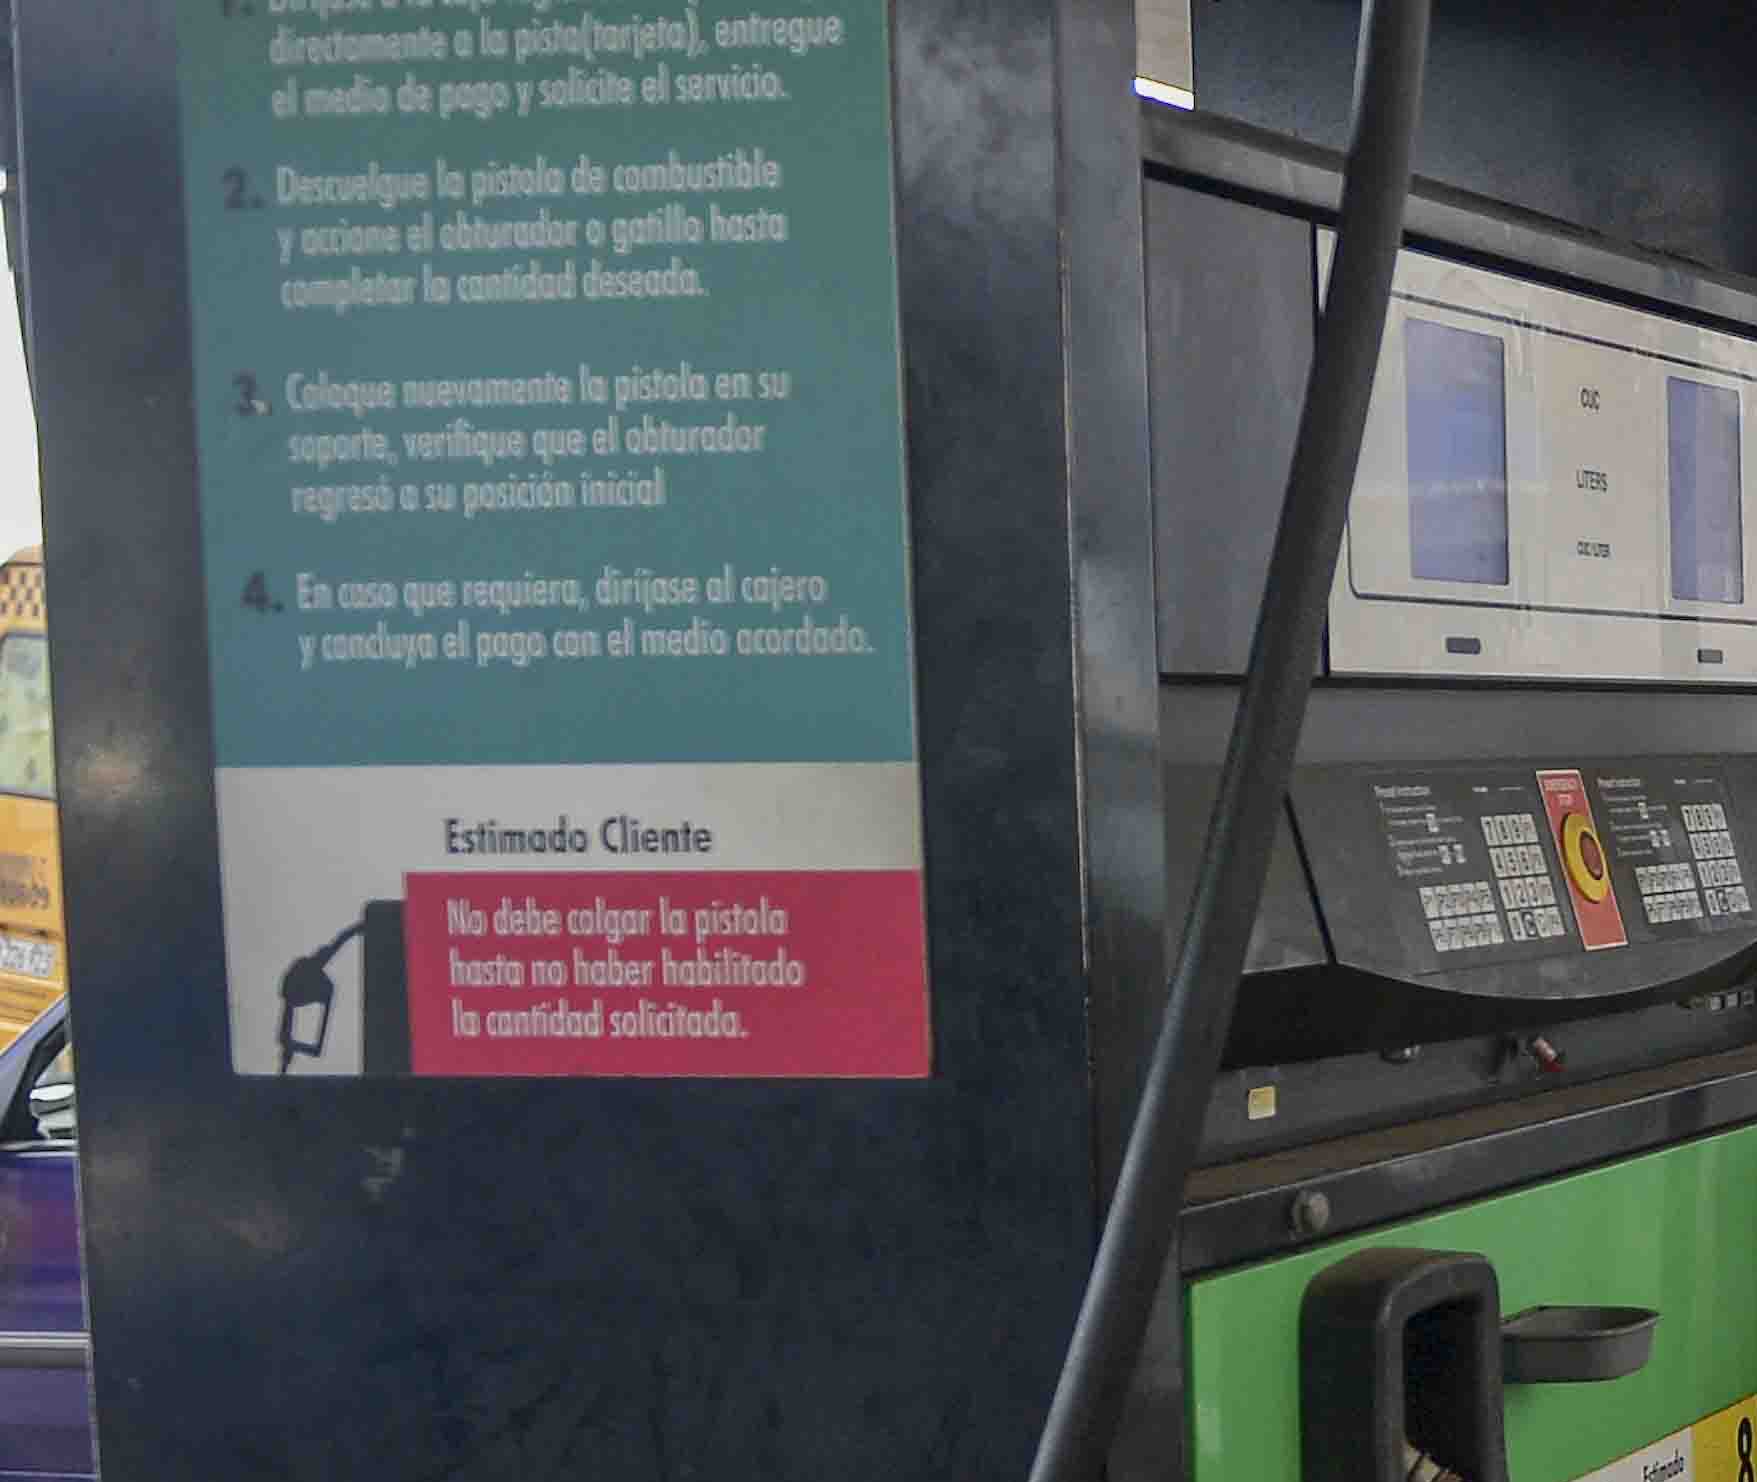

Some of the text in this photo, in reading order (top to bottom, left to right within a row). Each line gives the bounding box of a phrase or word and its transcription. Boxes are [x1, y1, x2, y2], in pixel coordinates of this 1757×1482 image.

[453, 30, 473, 56] a
[480, 16, 507, 55] la
[715, 14, 842, 53] entregue
[271, 62, 788, 118] el medio de pago y solicite el servicio.
[222, 148, 782, 209] 2. Descuelgue la pistola de combustible
[277, 203, 787, 263] y accione el obturador o gatillo hasta
[282, 257, 708, 313] completar la cantidad deseada.
[285, 370, 394, 417] Coloque
[402, 372, 569, 409] nuevamente
[580, 364, 608, 401] la
[615, 361, 708, 410] pistola
[715, 371, 750, 400] en
[759, 371, 788, 400] su
[288, 412, 765, 469] soporte, verifique que el obturador
[400, 484, 418, 511] a
[424, 483, 454, 510] su
[463, 471, 574, 518] posición
[241, 571, 284, 614] 4.
[296, 573, 331, 608] En
[338, 582, 397, 608] caso
[403, 580, 453, 616] que
[463, 570, 588, 613] requiera,
[705, 564, 735, 603] al
[741, 565, 827, 612] cajero
[300, 612, 876, 669] y concluya el pago con el medio acordado.
[443, 814, 713, 853] Estimado Cliente
[447, 896, 789, 944] No debe colgar la pistola
[450, 946, 806, 986] hasta no haber habilitado
[452, 997, 748, 1037] la cantidad solicitada.
